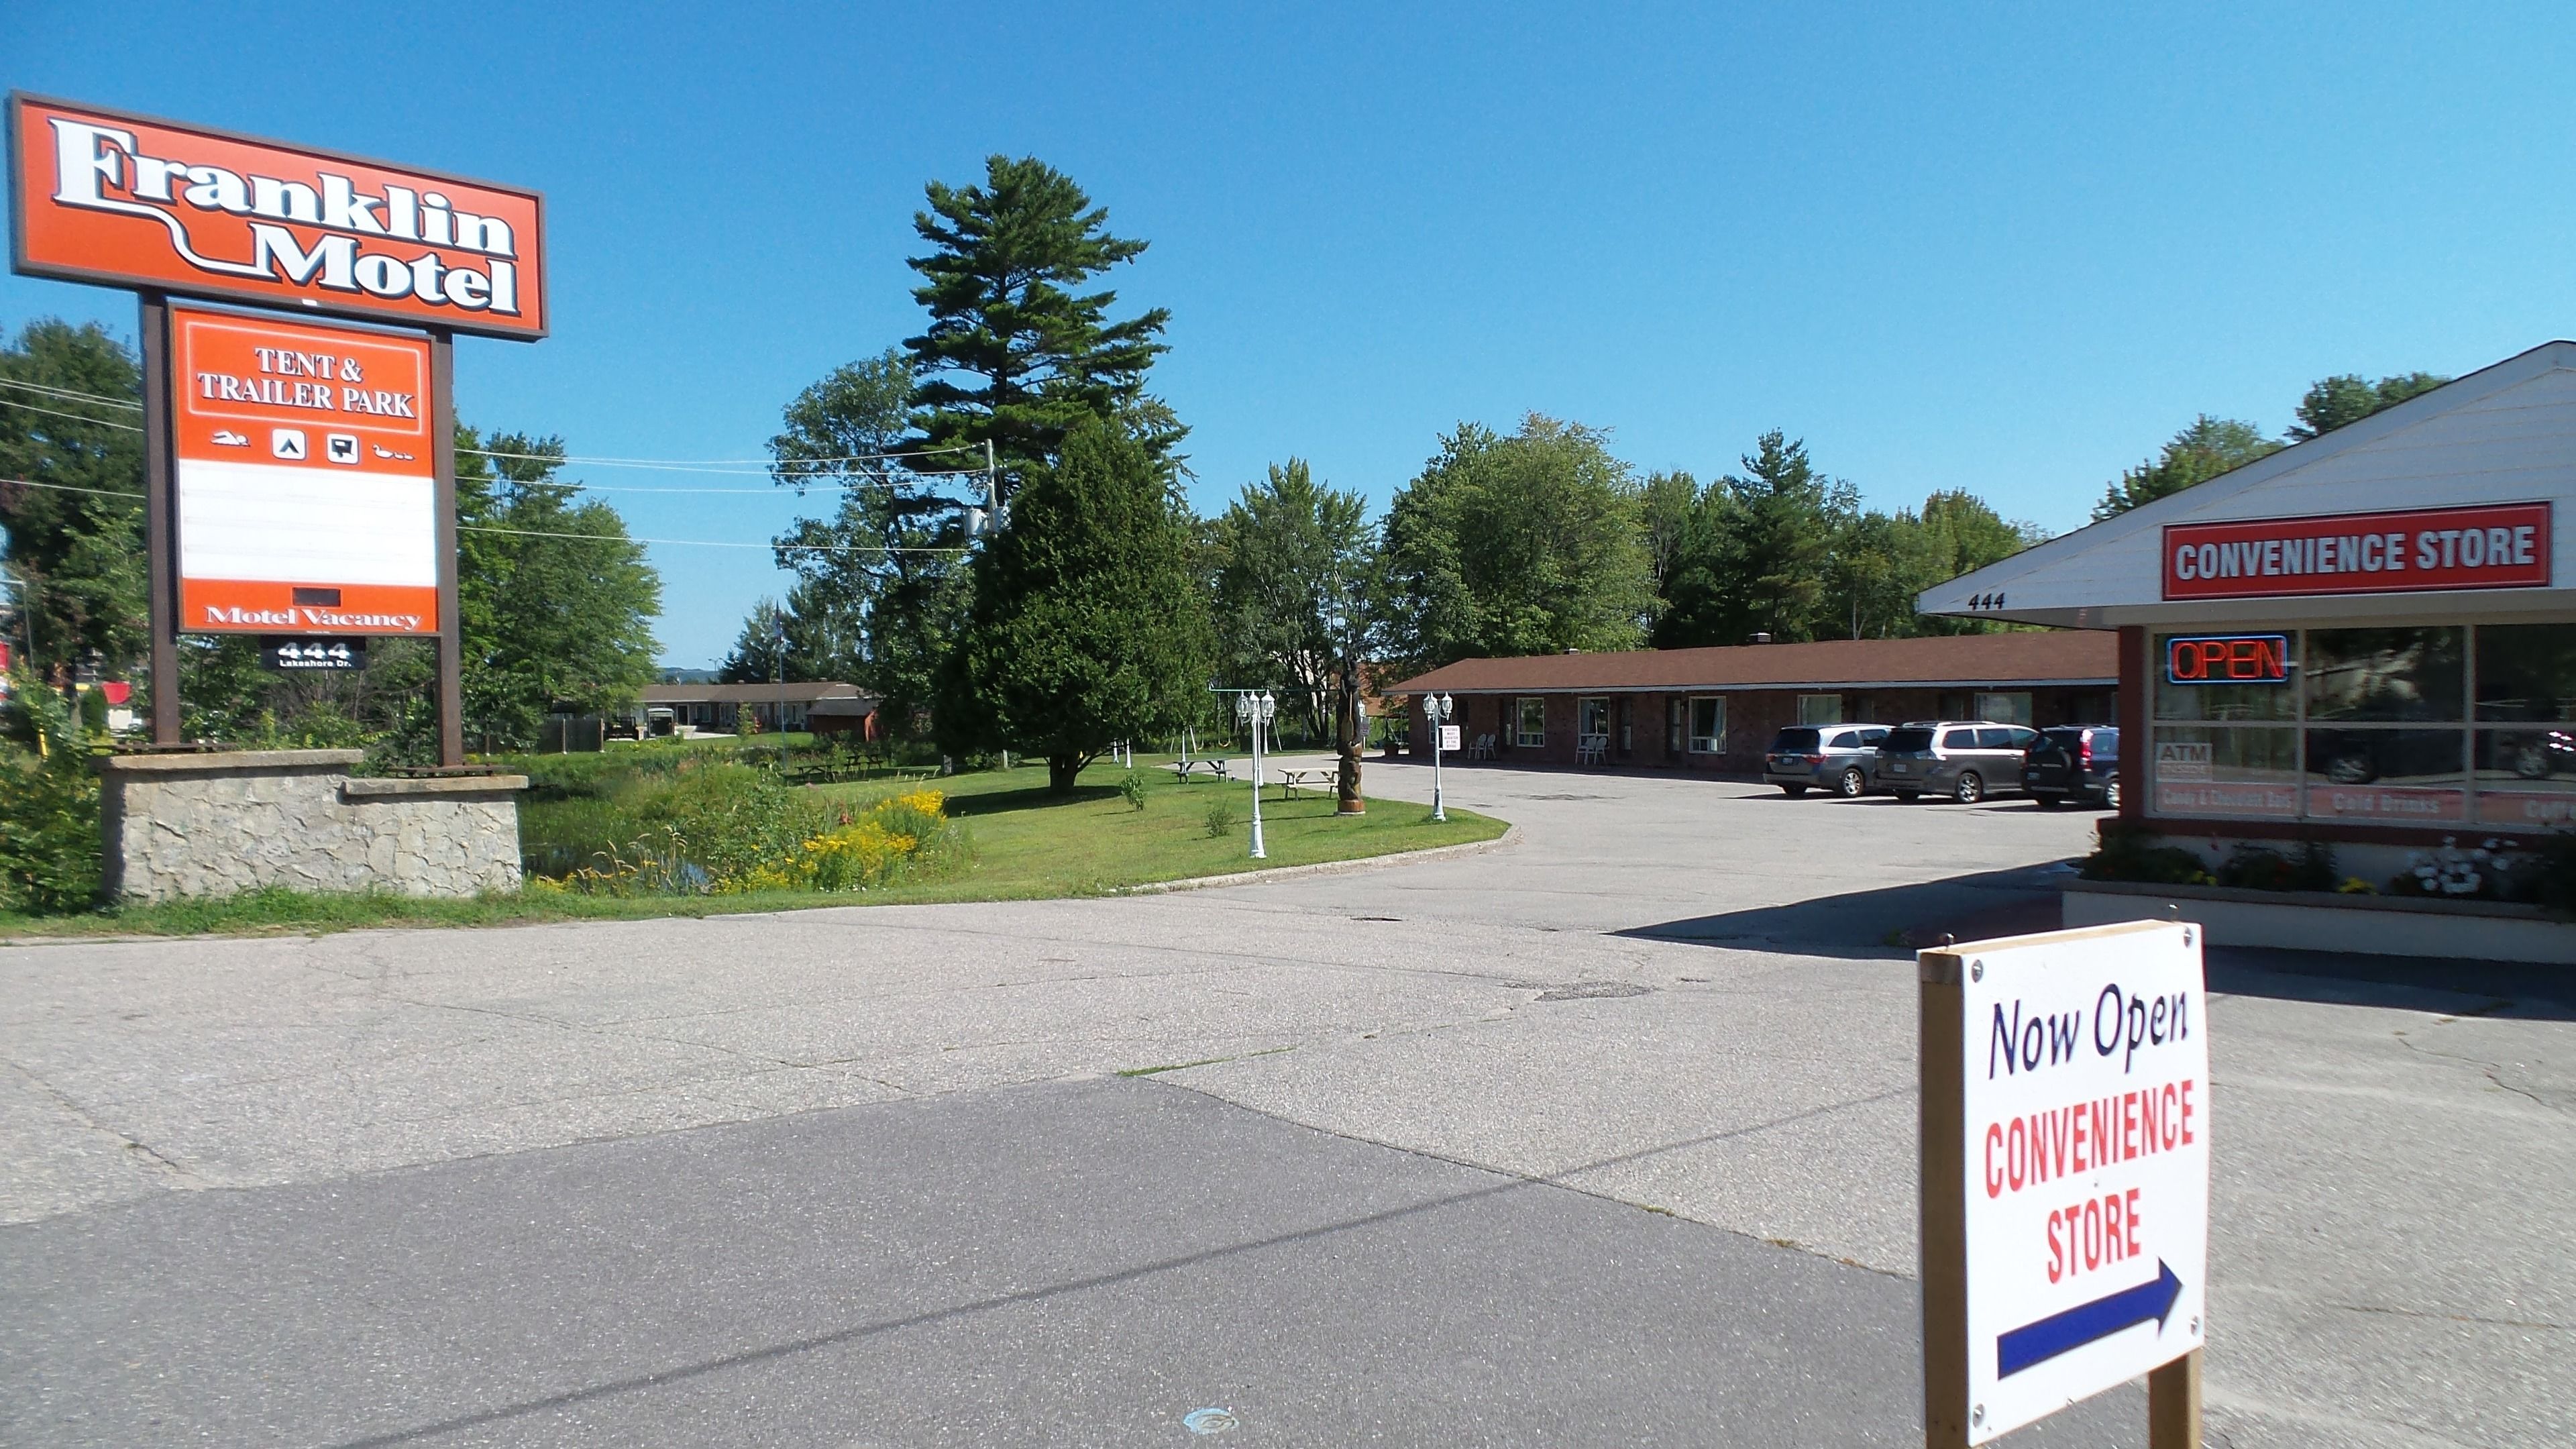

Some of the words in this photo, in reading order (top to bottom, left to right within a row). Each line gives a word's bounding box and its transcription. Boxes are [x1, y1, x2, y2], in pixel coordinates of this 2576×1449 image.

[48, 117, 518, 261] Franklin
[248, 222, 521, 317] Motel
[255, 347, 335, 380] TENT
[339, 357, 364, 383] &
[197, 372, 335, 411] TRAILER
[341, 386, 416, 419] PARK
[2175, 533, 2406, 581] CONVENIENCE
[2415, 525, 2536, 570] STORE
[205, 606, 297, 625] Motel
[301, 608, 421, 631] Vacancy
[1968, 592, 2006, 610] 444
[278, 642, 351, 659] 444
[279, 659, 334, 667] Lakeshore
[336, 659, 353, 667] Dr.
[2171, 639, 2285, 679] OPEN
[2160, 745, 2207, 761] ATM
[1988, 999, 2081, 1081] Now
[2094, 983, 2188, 1075] Open
[1986, 1079, 2194, 1199] CONVENIENCE
[2047, 1187, 2141, 1285] STORE
